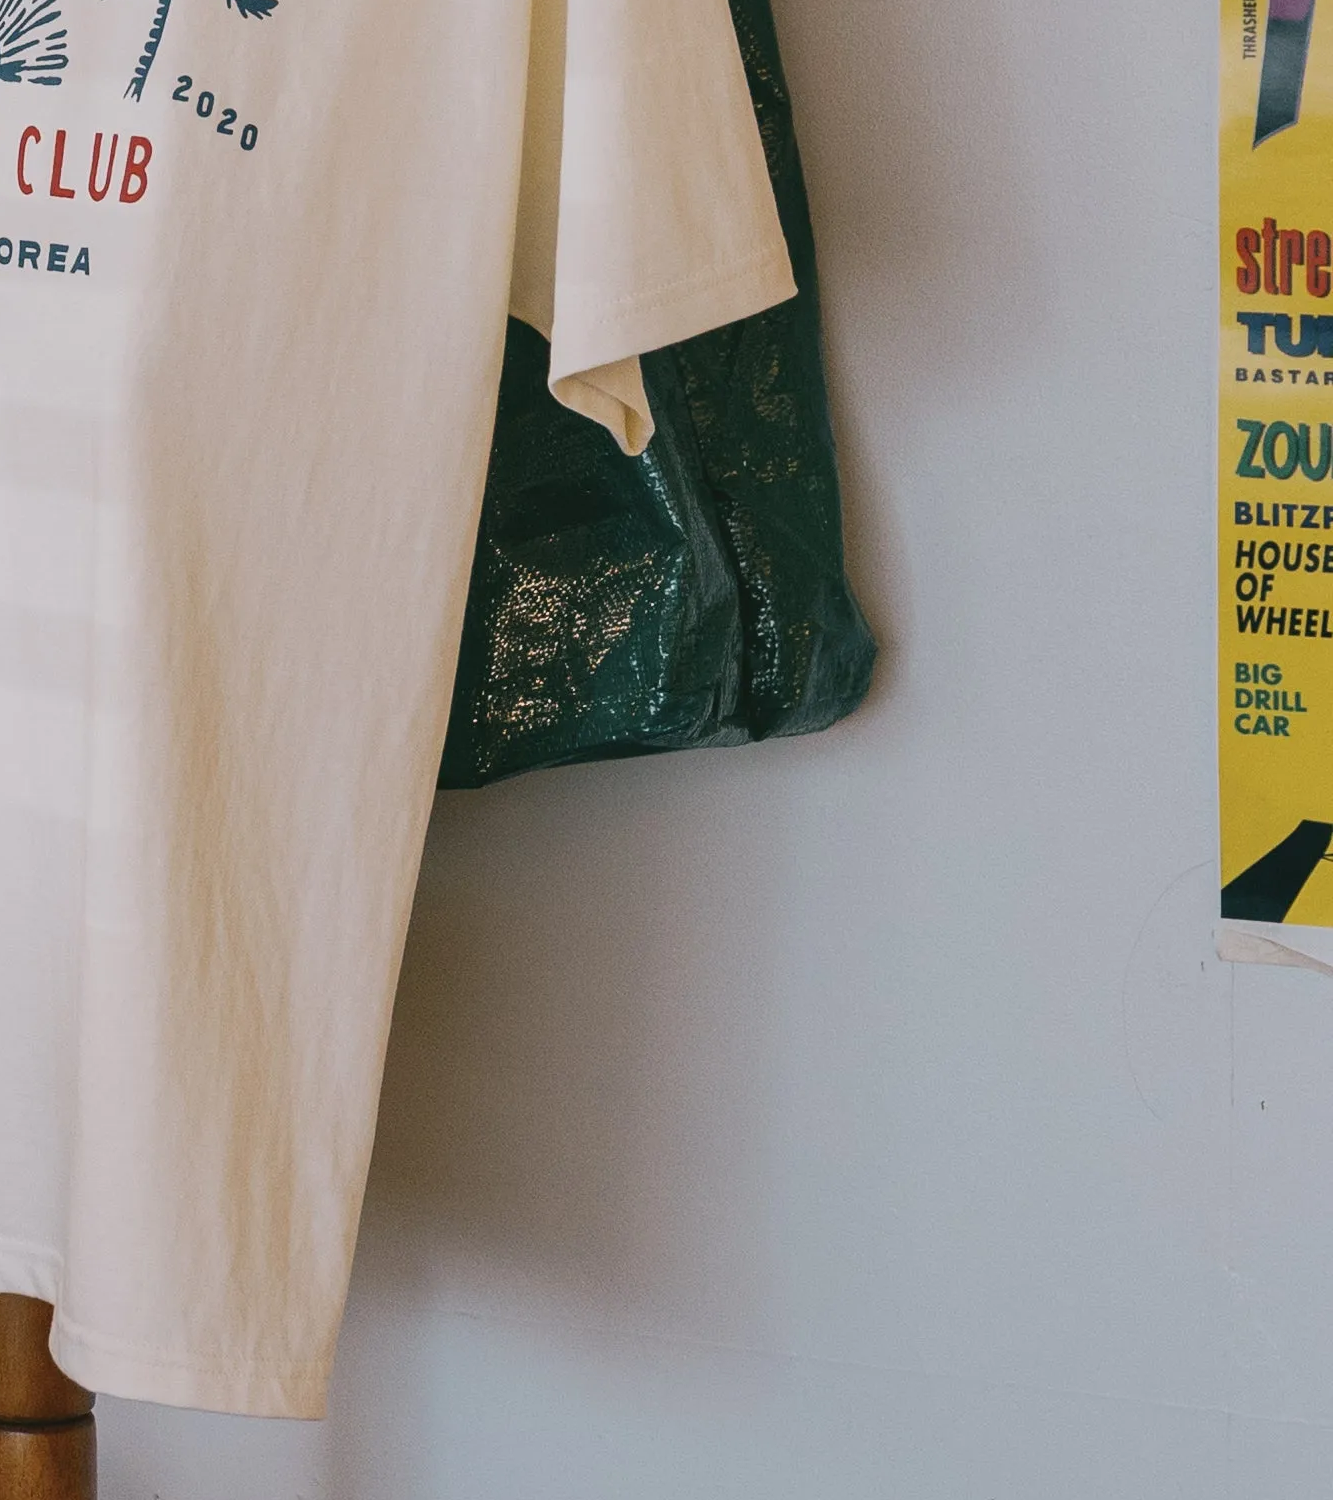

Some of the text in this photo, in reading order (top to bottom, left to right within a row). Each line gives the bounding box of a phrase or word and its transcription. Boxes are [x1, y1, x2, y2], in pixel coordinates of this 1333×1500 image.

[172, 75, 259, 151] 2020
[17, 126, 154, 204] CLUB
[1235, 539, 1333, 573] HOUSE
[1236, 572, 1275, 602] OF
[1235, 662, 1283, 685] BIG
[1235, 687, 1307, 713] DRILL
[1234, 713, 1290, 737] CAR
